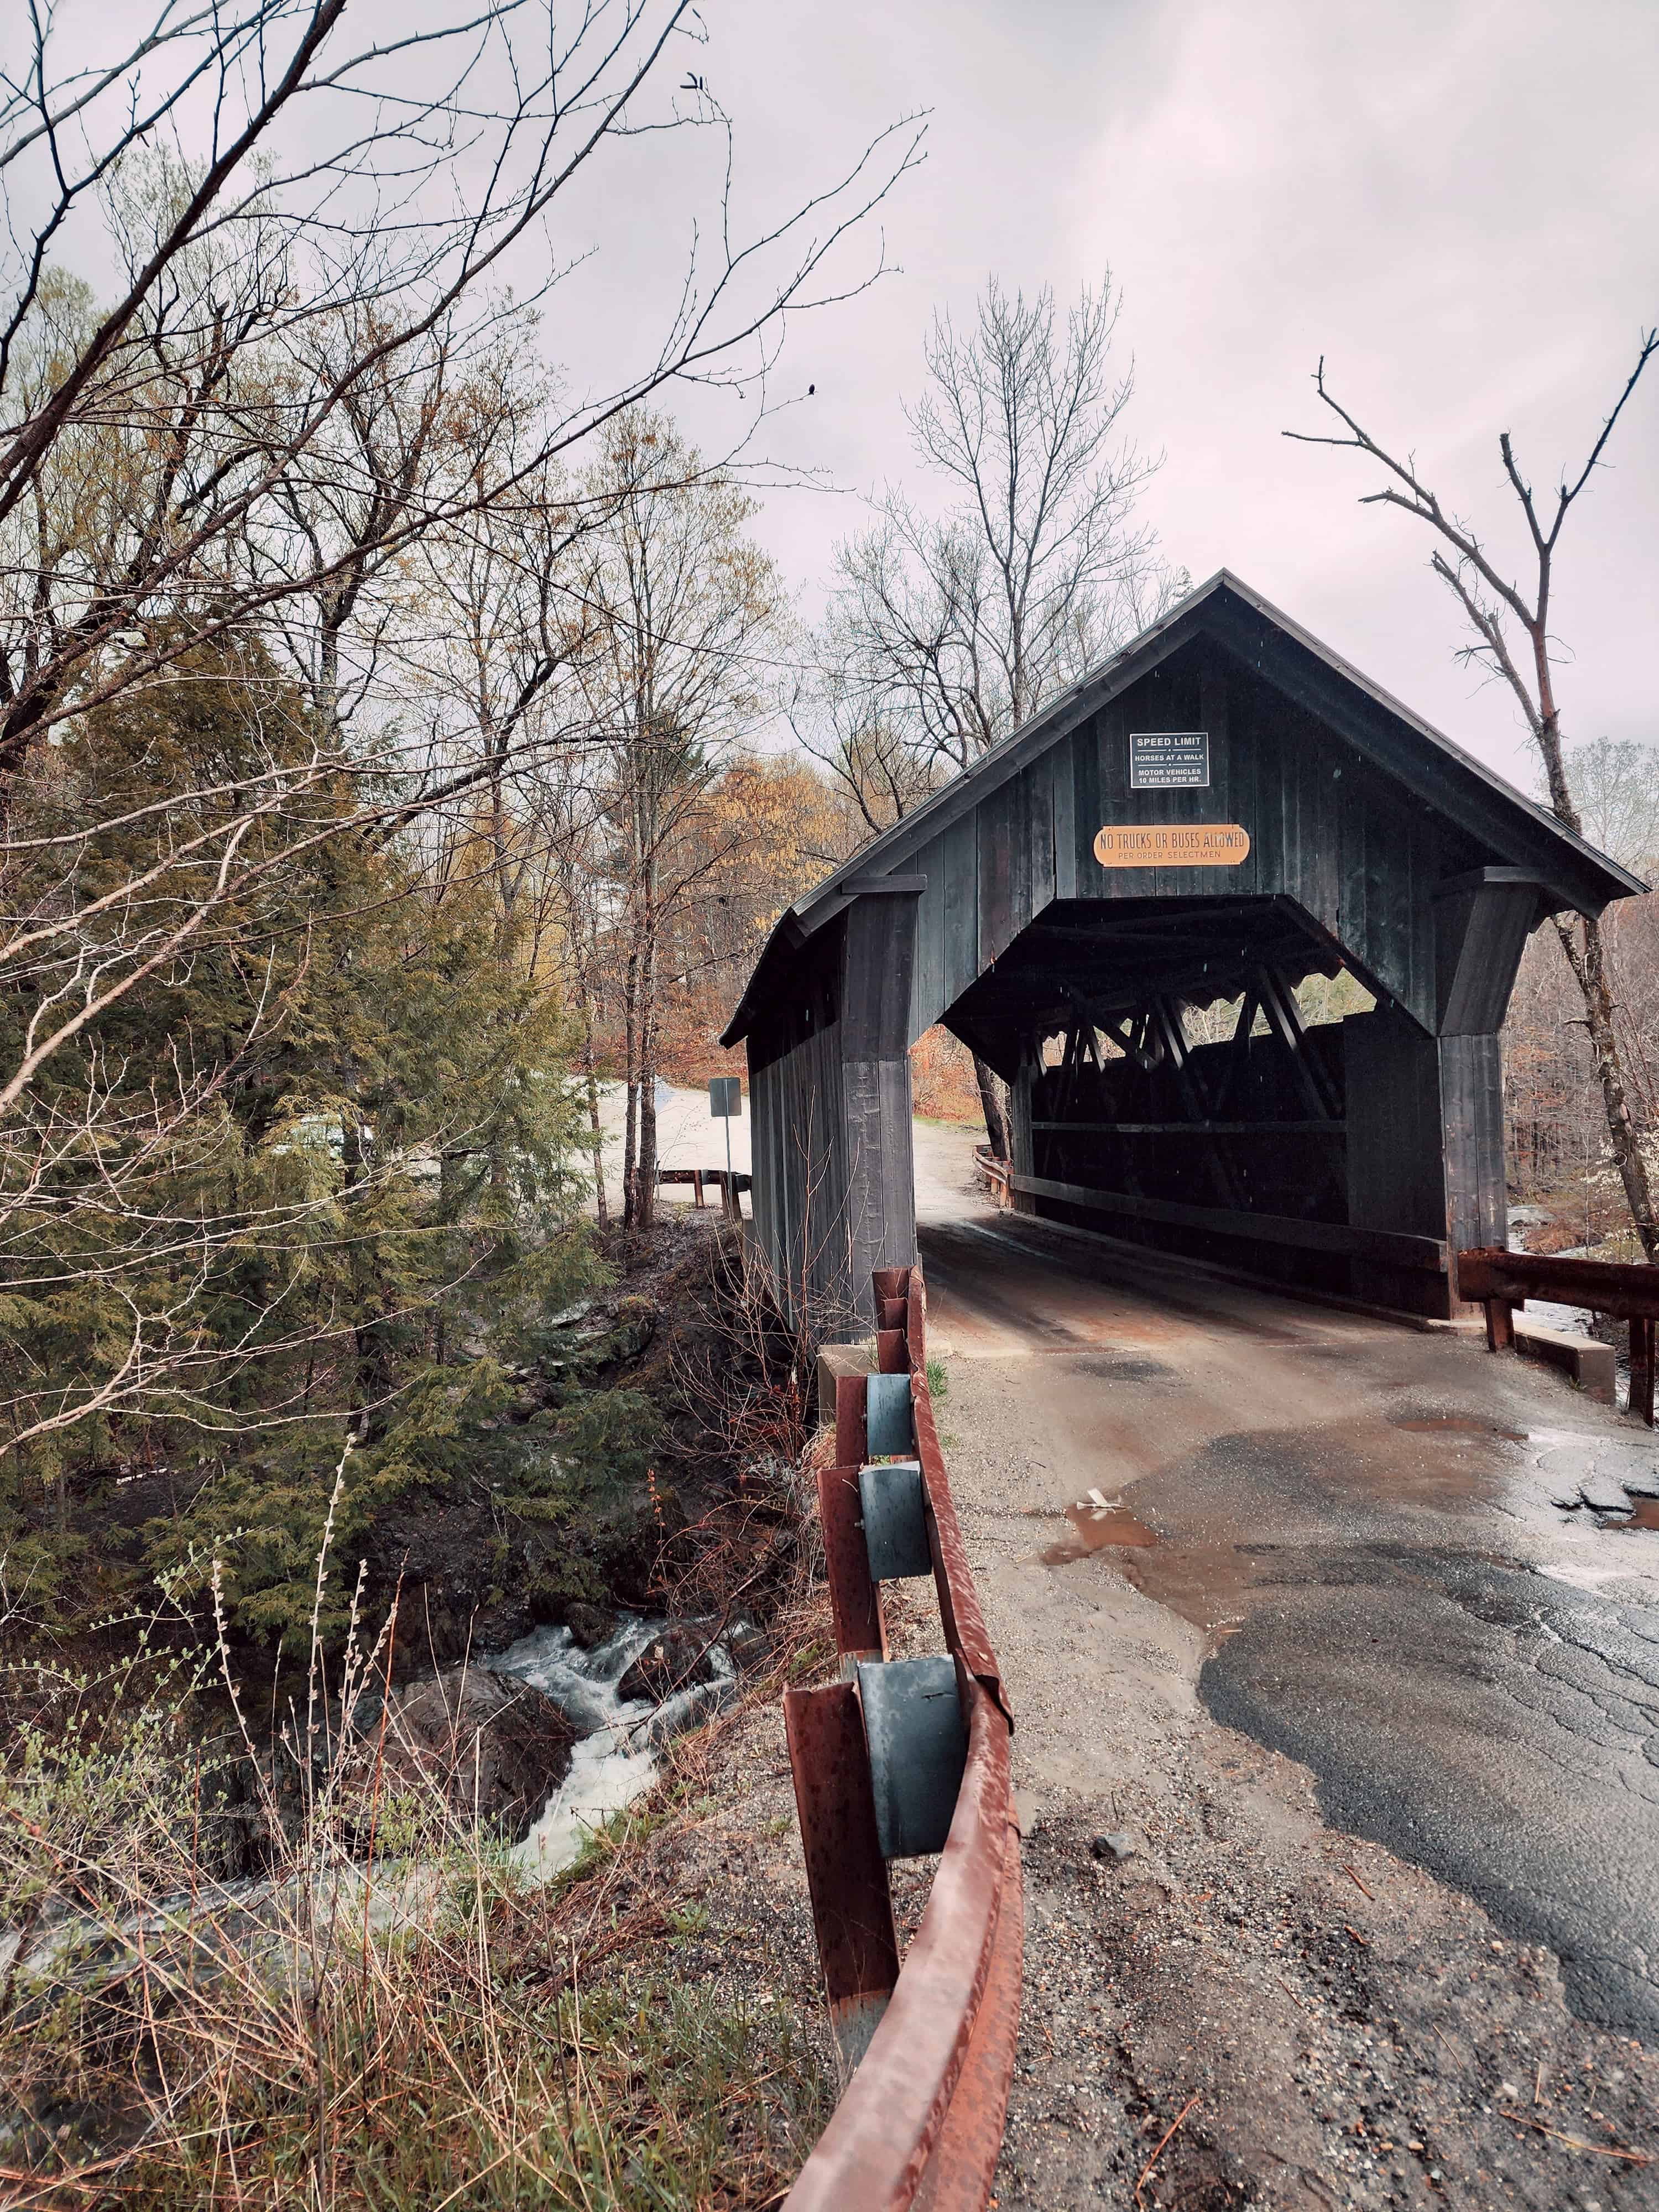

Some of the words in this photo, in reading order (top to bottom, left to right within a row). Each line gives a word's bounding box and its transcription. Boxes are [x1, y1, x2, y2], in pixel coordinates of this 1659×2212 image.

[1137, 738, 1171, 746] SPEED
[1175, 737, 1201, 745] LIMIT
[1100, 834, 1113, 849] NO
[1117, 833, 1151, 849] TRUCKS
[1156, 833, 1168, 848] OR
[1172, 832, 1199, 848] BUSES
[1203, 832, 1244, 847] ALLOWED
